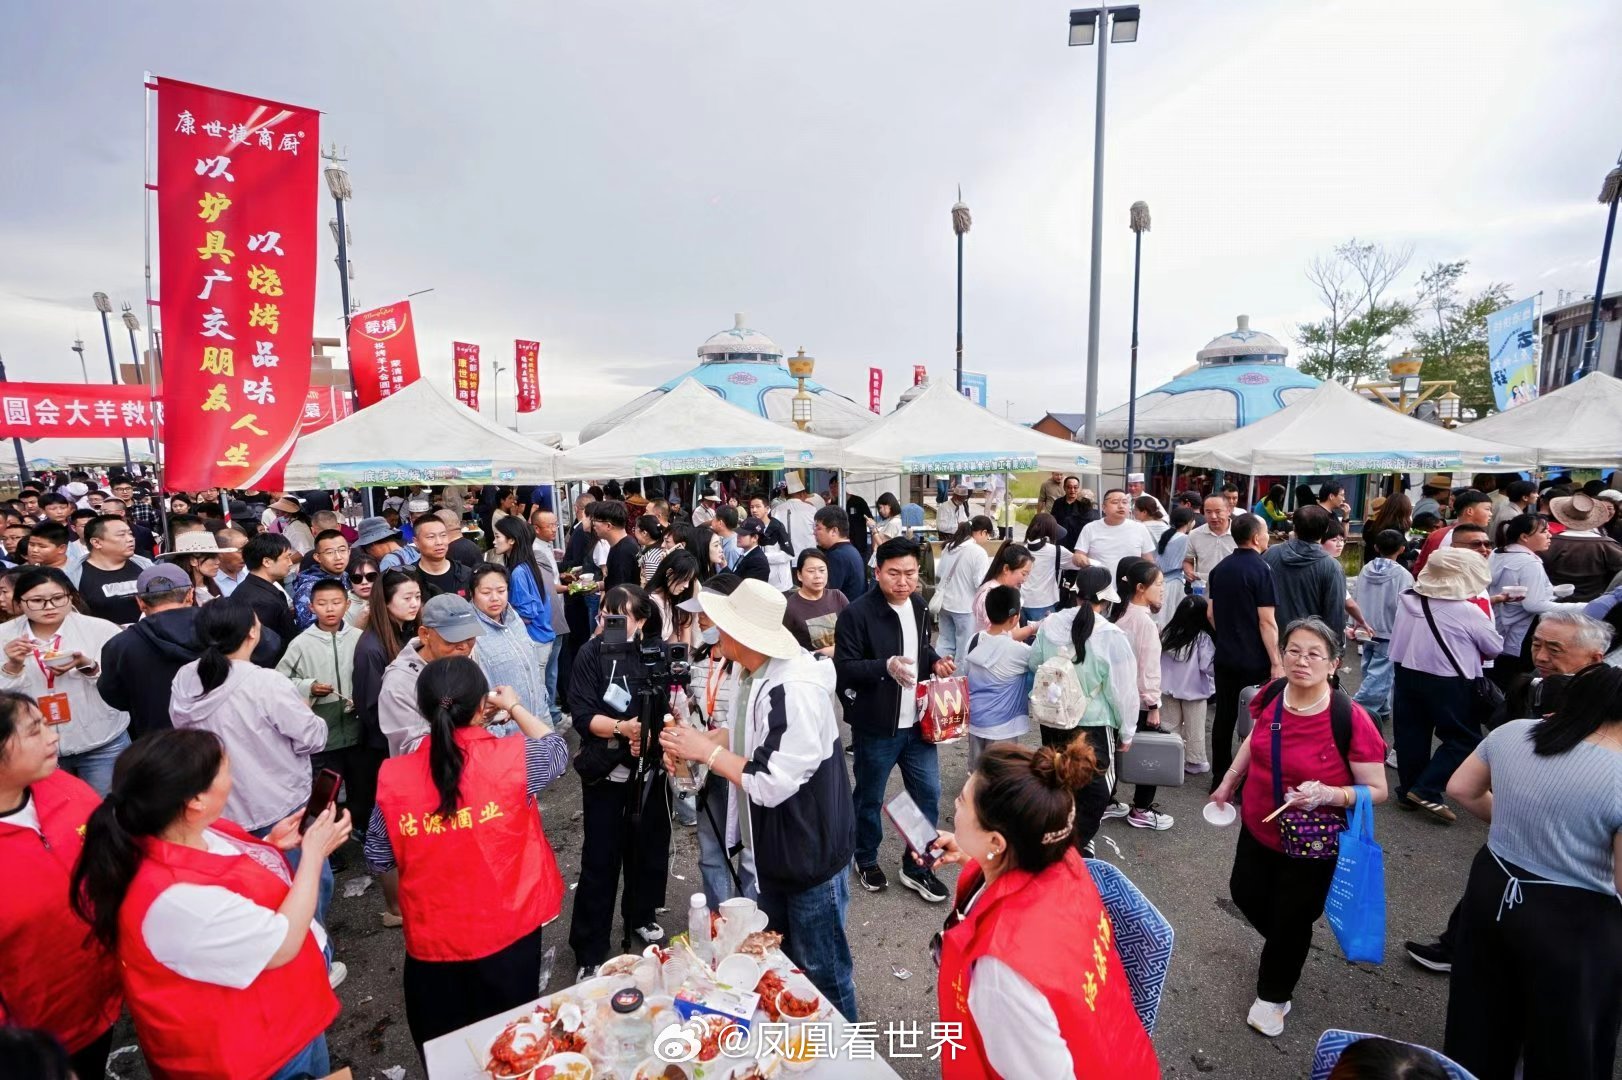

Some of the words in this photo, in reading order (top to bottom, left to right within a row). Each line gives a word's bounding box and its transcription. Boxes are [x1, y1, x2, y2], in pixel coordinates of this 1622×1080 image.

[195, 155, 236, 412] 以炉具广交朋友
